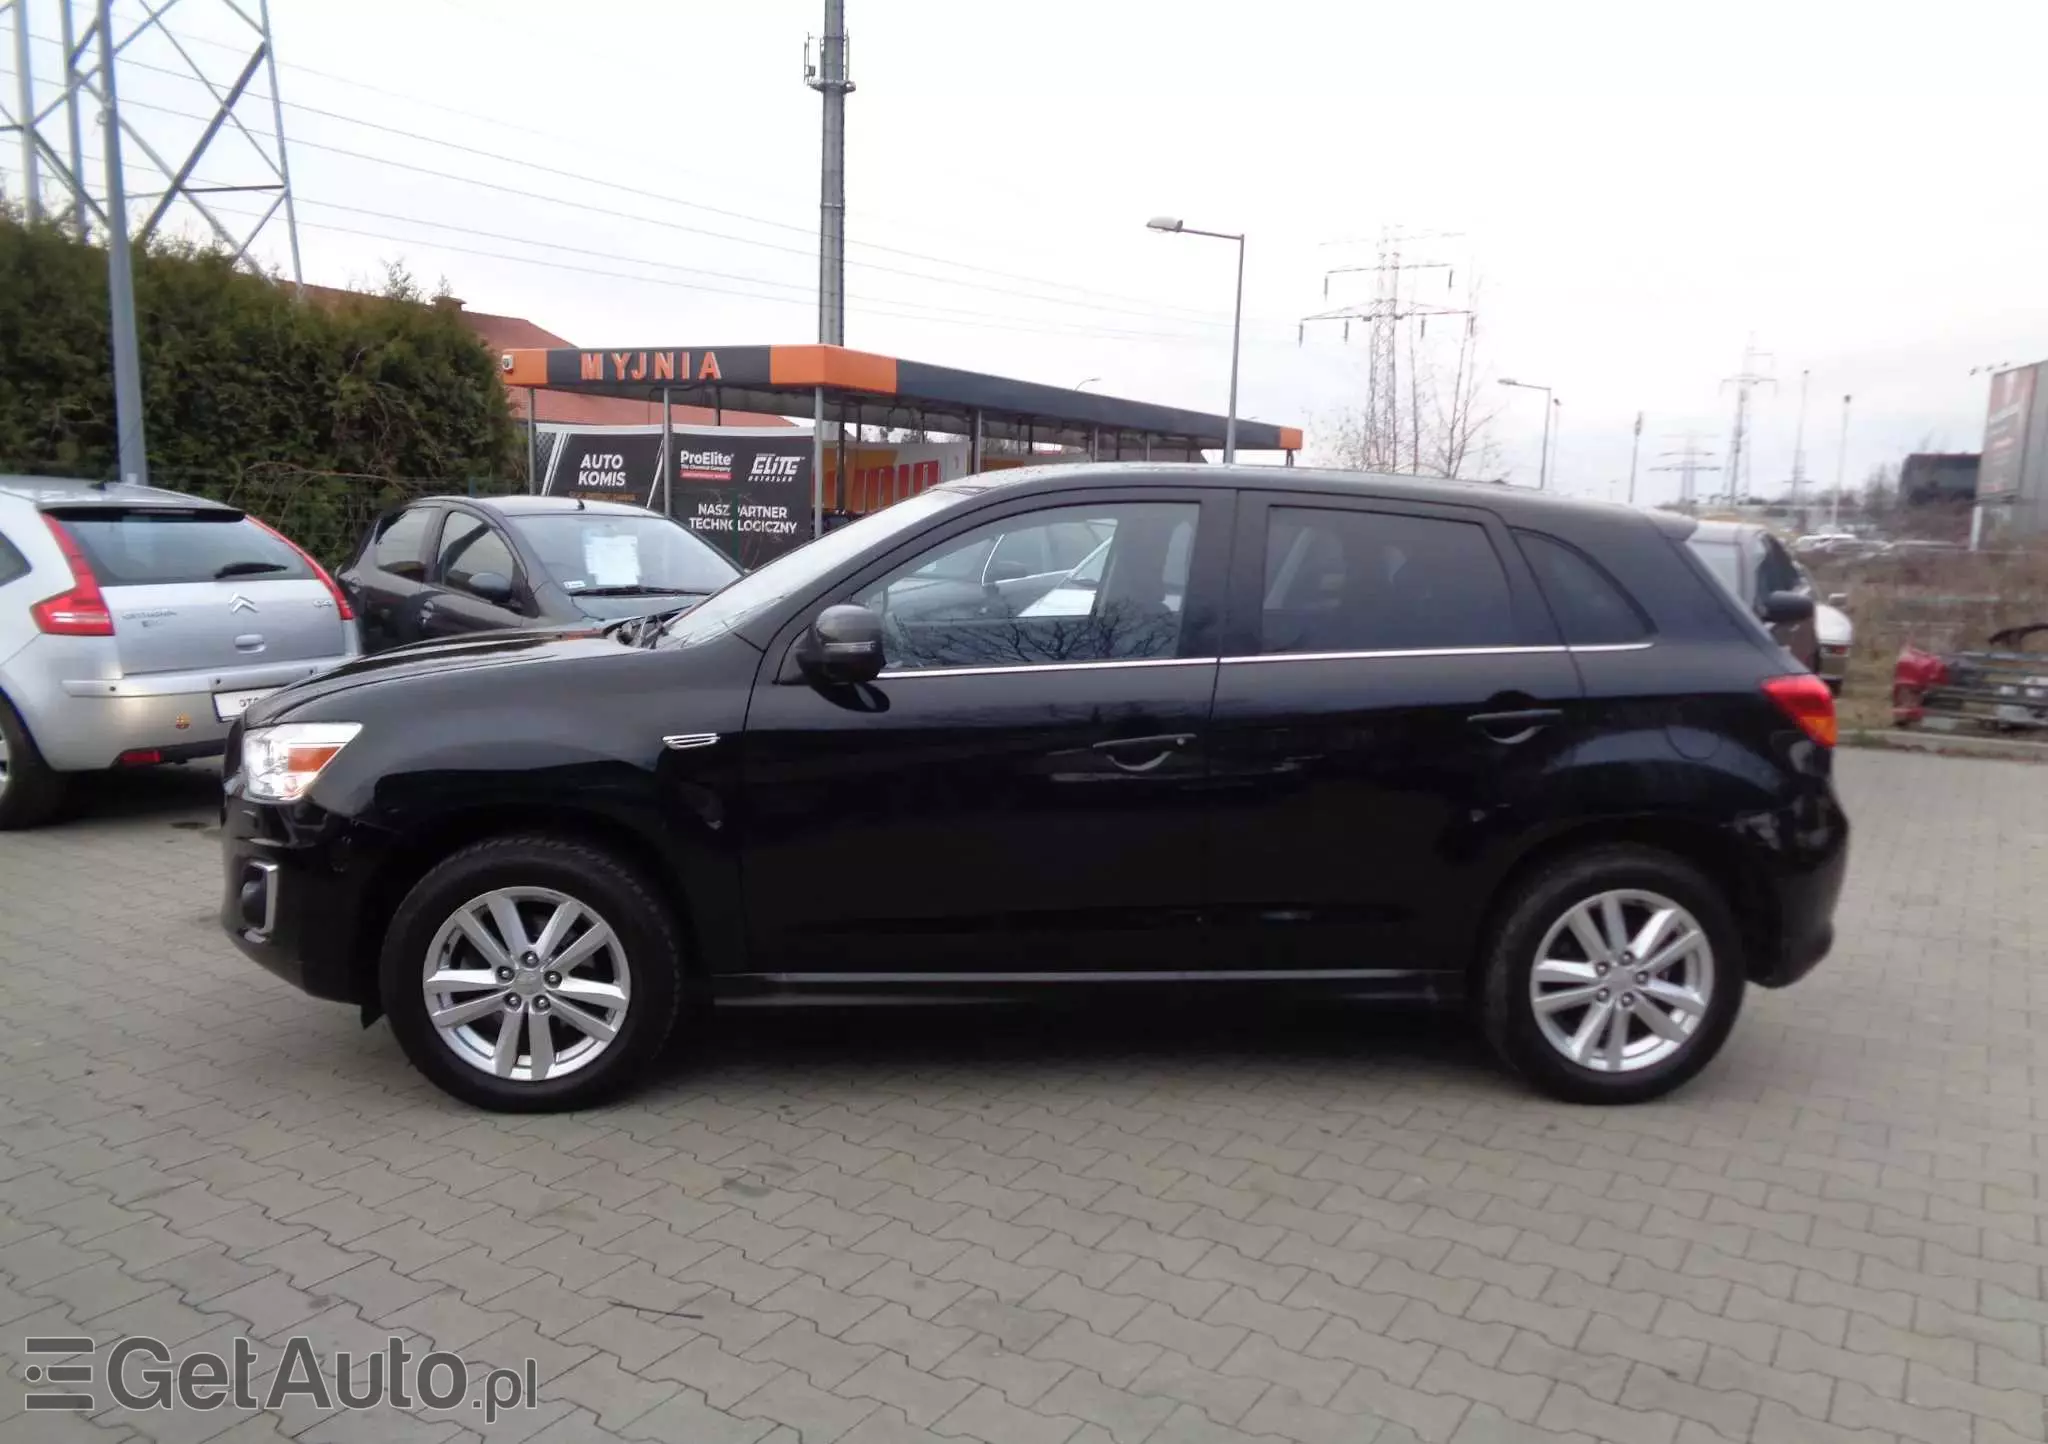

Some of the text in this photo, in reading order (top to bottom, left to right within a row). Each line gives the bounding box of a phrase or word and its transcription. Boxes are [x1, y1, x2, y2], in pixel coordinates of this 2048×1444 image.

[581, 351, 722, 380] MYJNIA
[580, 453, 624, 470] AUTO
[578, 470, 627, 487] KOMIS
[698, 503, 731, 517] NASZ
